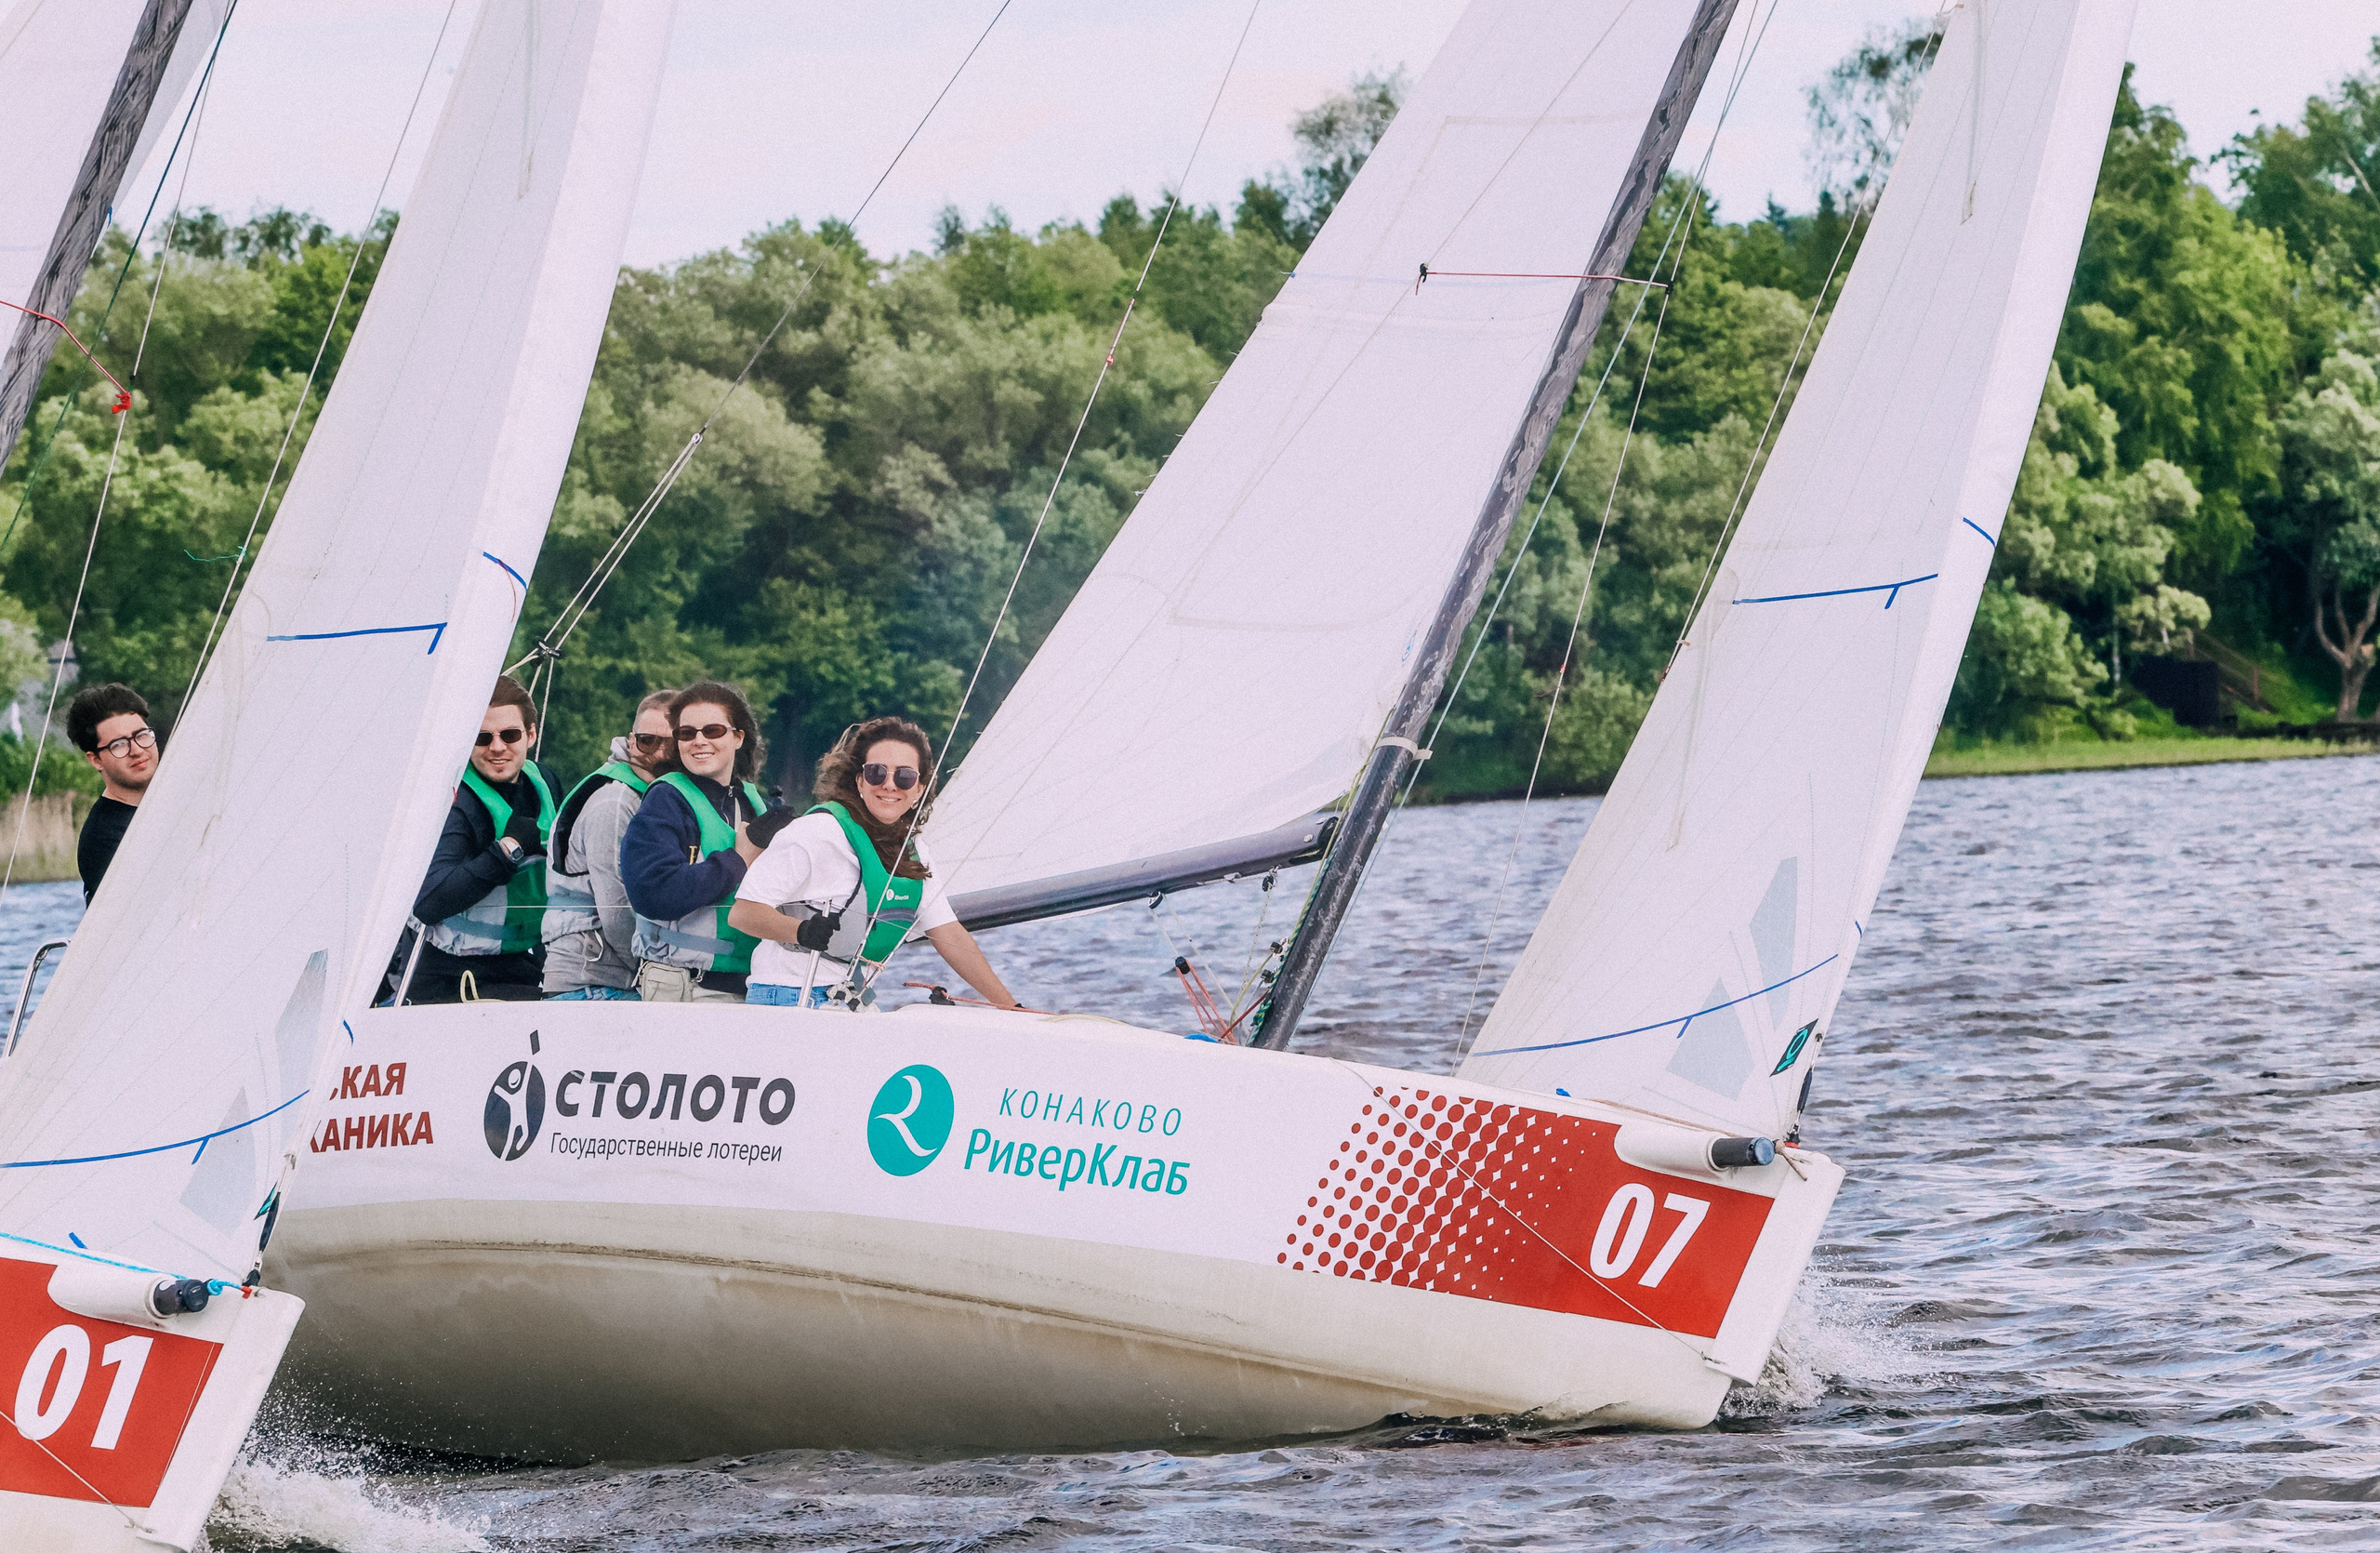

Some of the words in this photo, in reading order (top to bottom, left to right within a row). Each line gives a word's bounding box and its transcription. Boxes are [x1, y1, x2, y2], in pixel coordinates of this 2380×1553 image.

[329, 1062, 407, 1101] КАЯ
[555, 1069, 796, 1126] СТОЛОТО
[998, 1087, 1182, 1136] КОНАКОВО
[550, 1132, 703, 1161] Государственные
[707, 1142, 783, 1166] лотереи
[963, 1127, 1191, 1196] РиверКлаб
[1589, 1182, 1712, 1289] 07
[13, 1323, 154, 1451] 01
